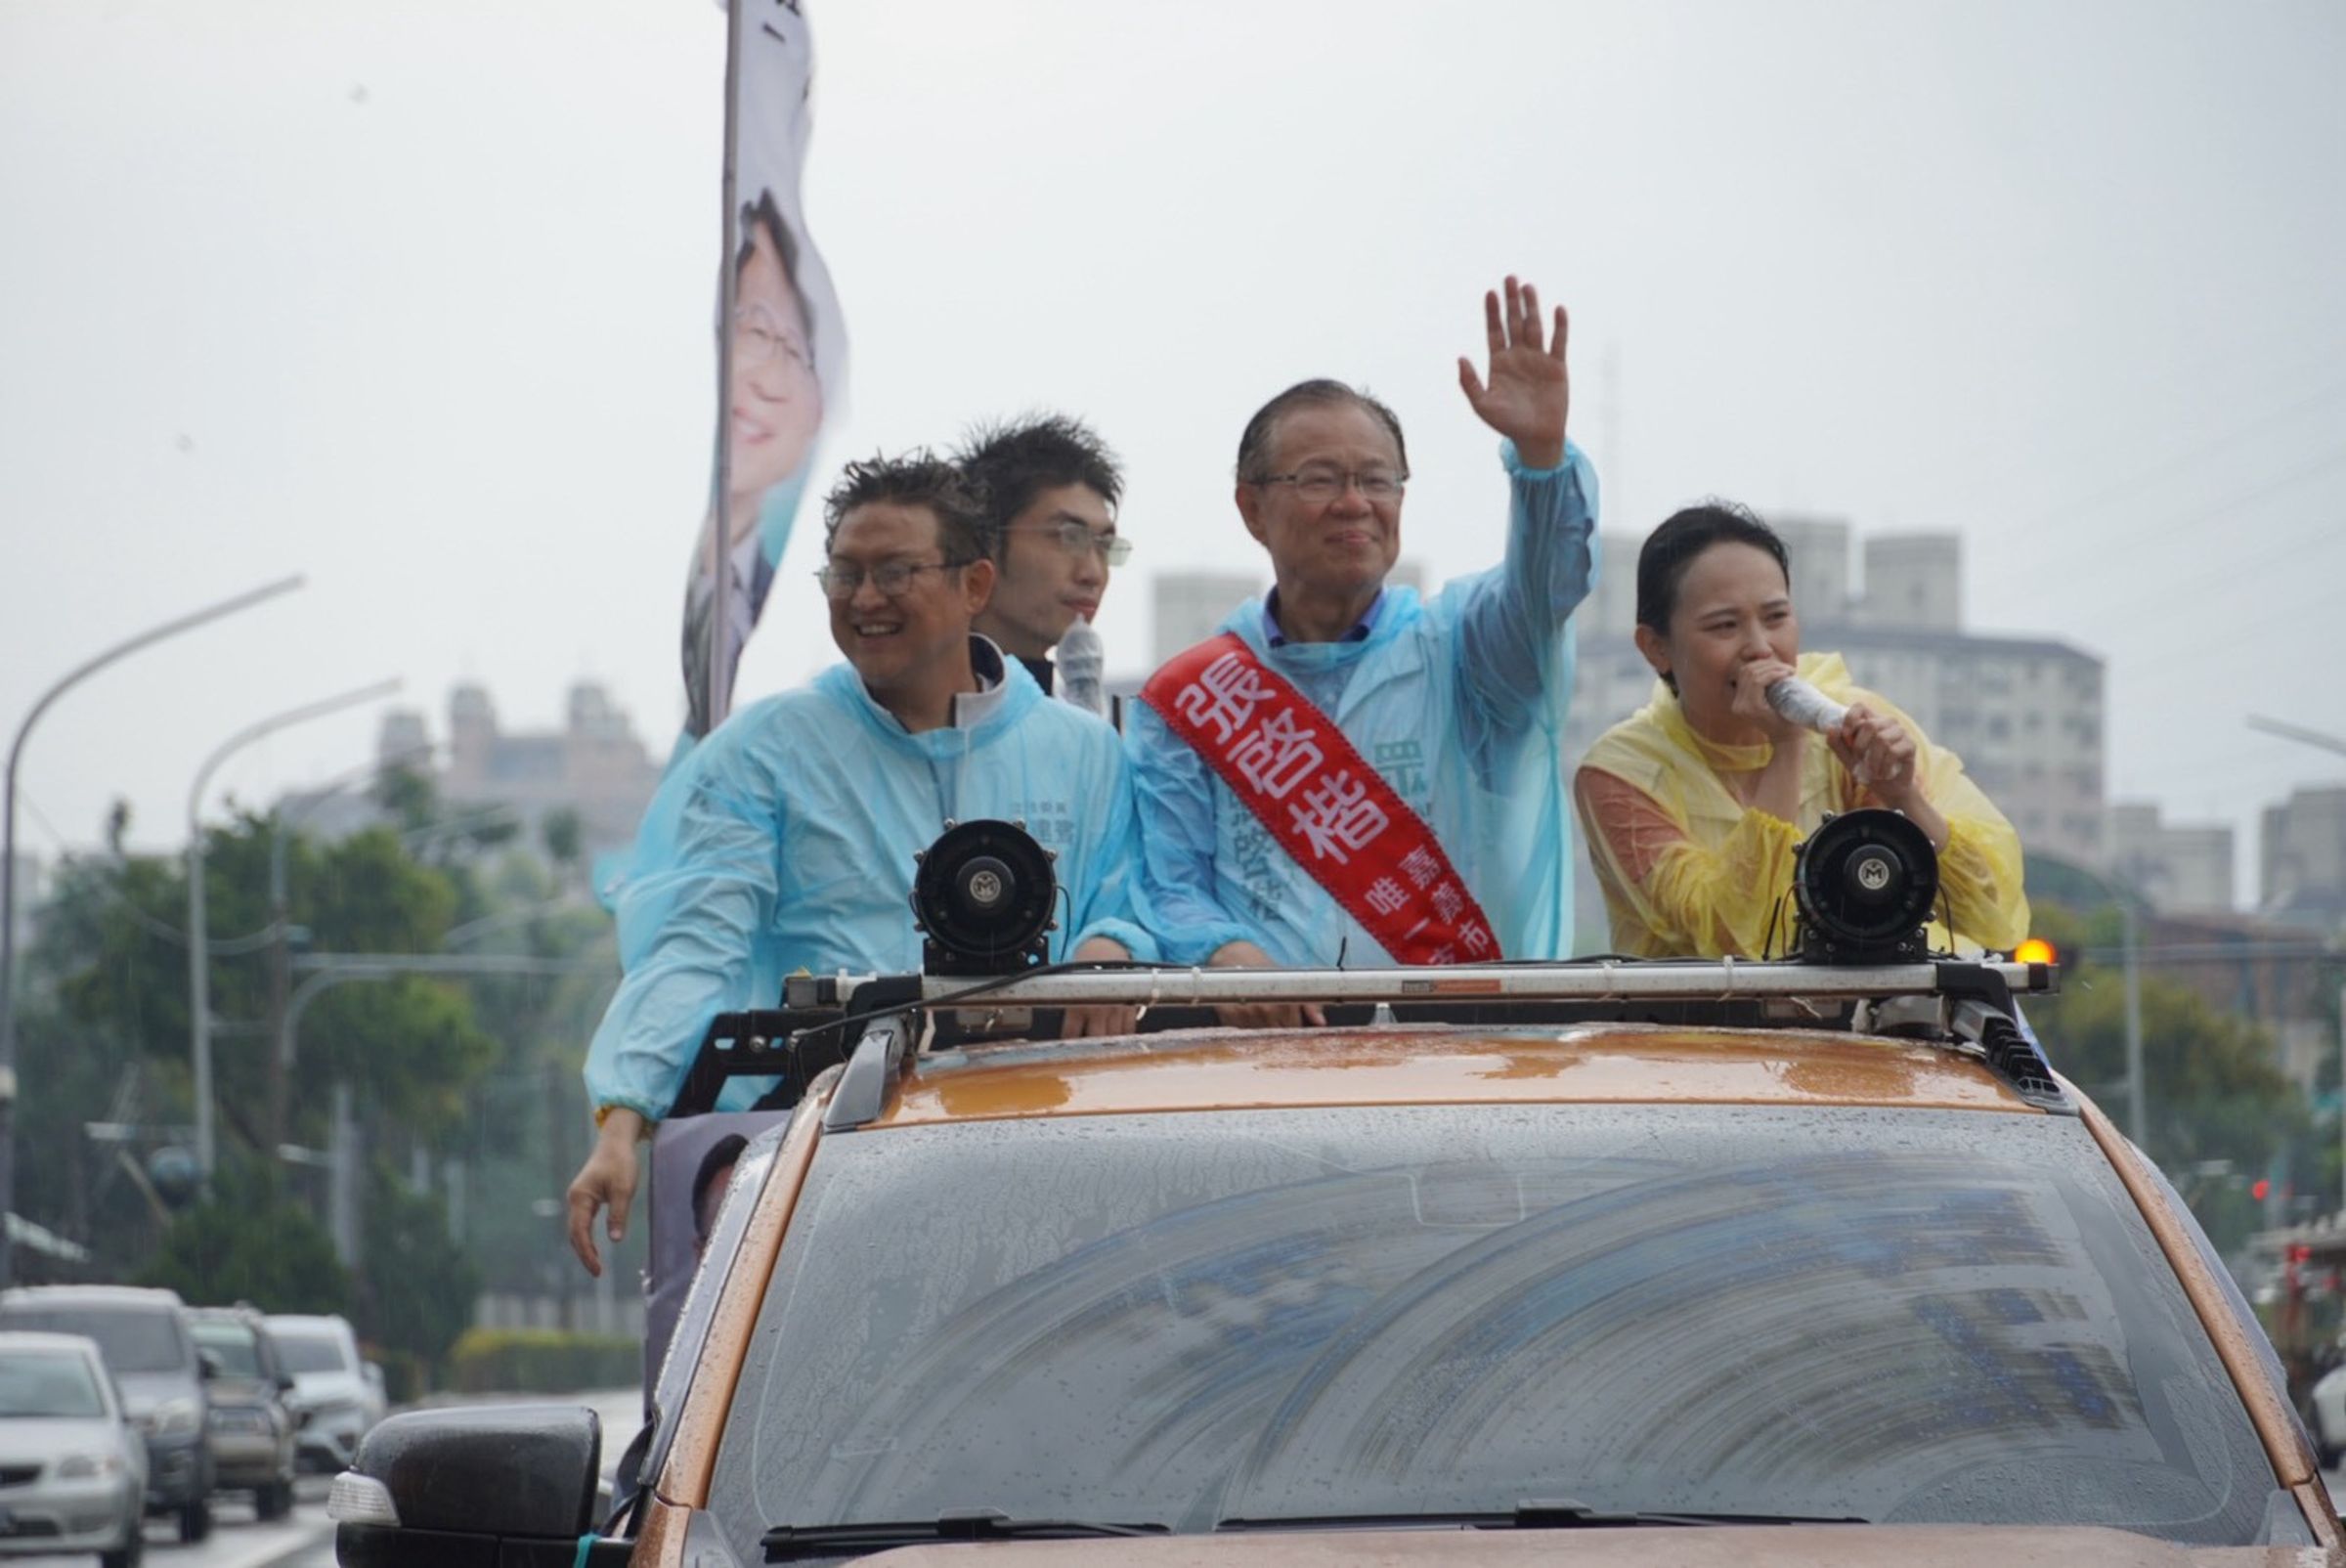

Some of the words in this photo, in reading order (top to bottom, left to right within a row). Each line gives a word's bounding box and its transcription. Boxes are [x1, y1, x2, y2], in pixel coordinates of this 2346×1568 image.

[1175, 651, 1389, 865] 張啓楷
[1397, 844, 1490, 956] 嘉義市
